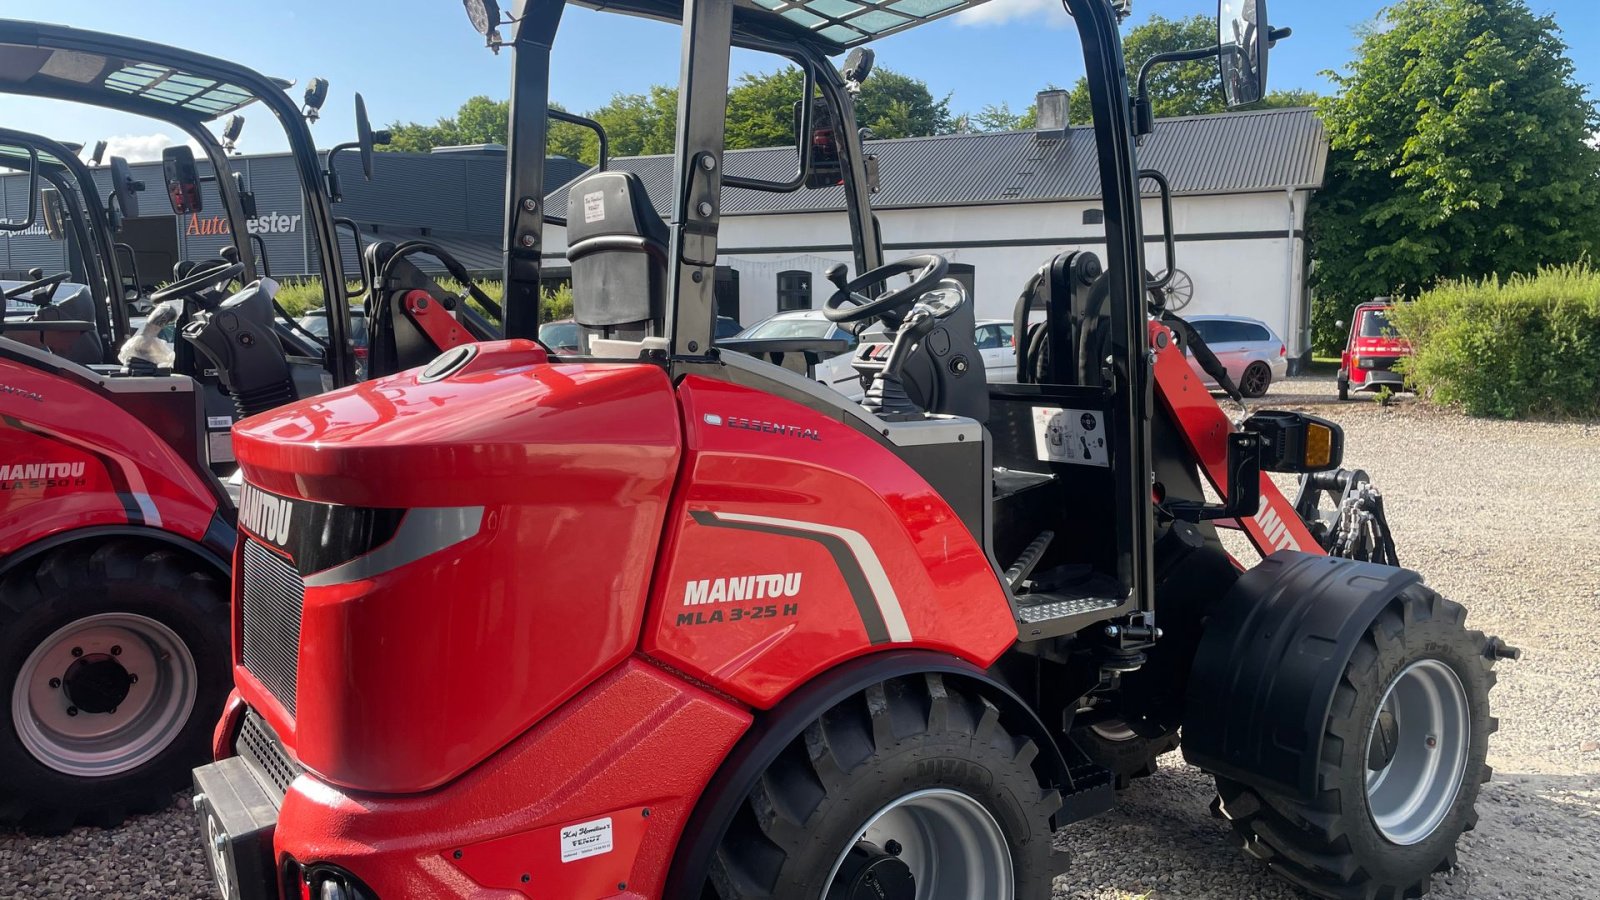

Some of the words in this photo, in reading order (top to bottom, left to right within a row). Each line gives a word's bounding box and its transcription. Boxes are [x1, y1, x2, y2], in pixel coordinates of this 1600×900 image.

[728, 416, 822, 441] ESSENTIAL
[684, 572, 802, 606] MANITOU
[676, 609, 724, 627] MLA
[729, 604, 778, 622] 3-25
[783, 603, 799, 616] H
